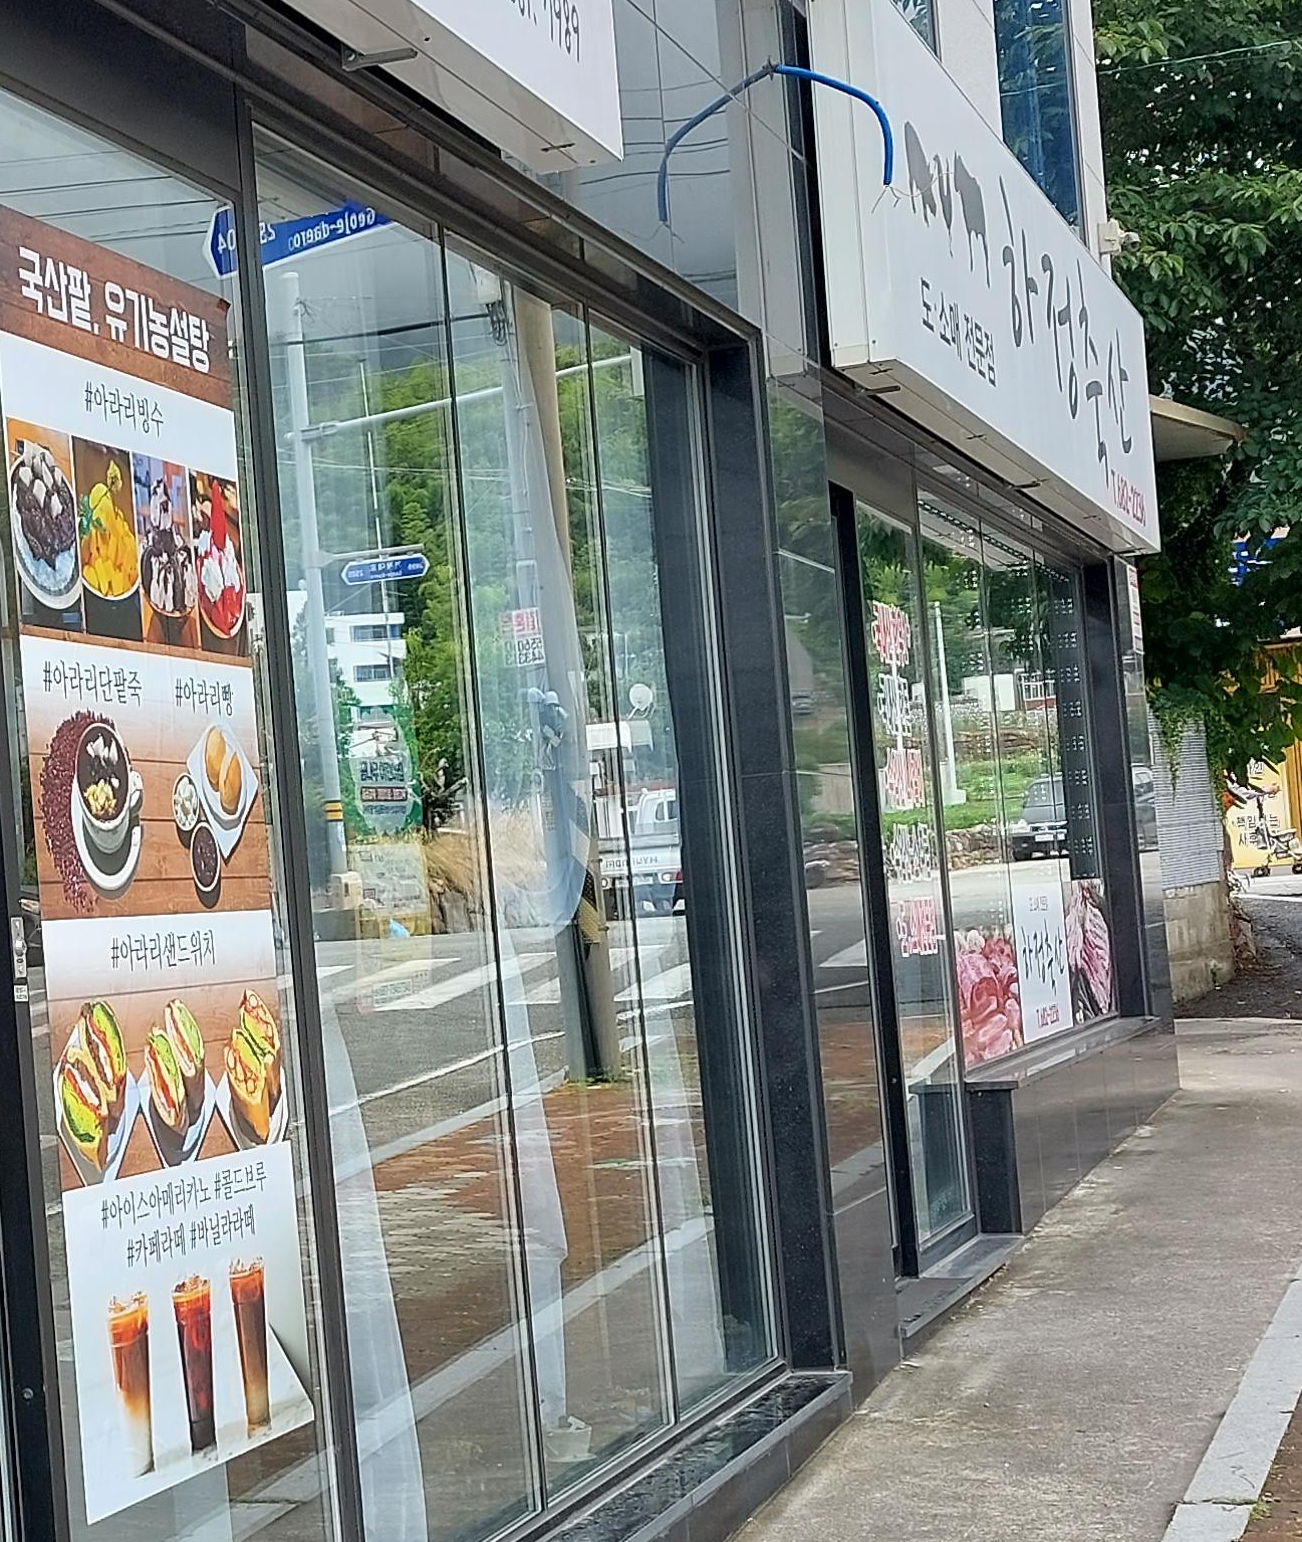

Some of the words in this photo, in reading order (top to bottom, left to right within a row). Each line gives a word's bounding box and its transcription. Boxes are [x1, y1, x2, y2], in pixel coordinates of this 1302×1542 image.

[104, 281, 210, 374] 유기농설탕
[963, 313, 997, 388] 전문점
[84, 380, 164, 438] #아라리빙수
[42, 659, 142, 707] #아라리단팥죽
[110, 929, 216, 971] #아라리샌드위치
[101, 1176, 211, 1229] #아이스아메리카노
[214, 1161, 267, 1200] #콜드브루
[127, 1223, 186, 1268] #카페라떼
[191, 1203, 256, 1249] #바닐라라떼
